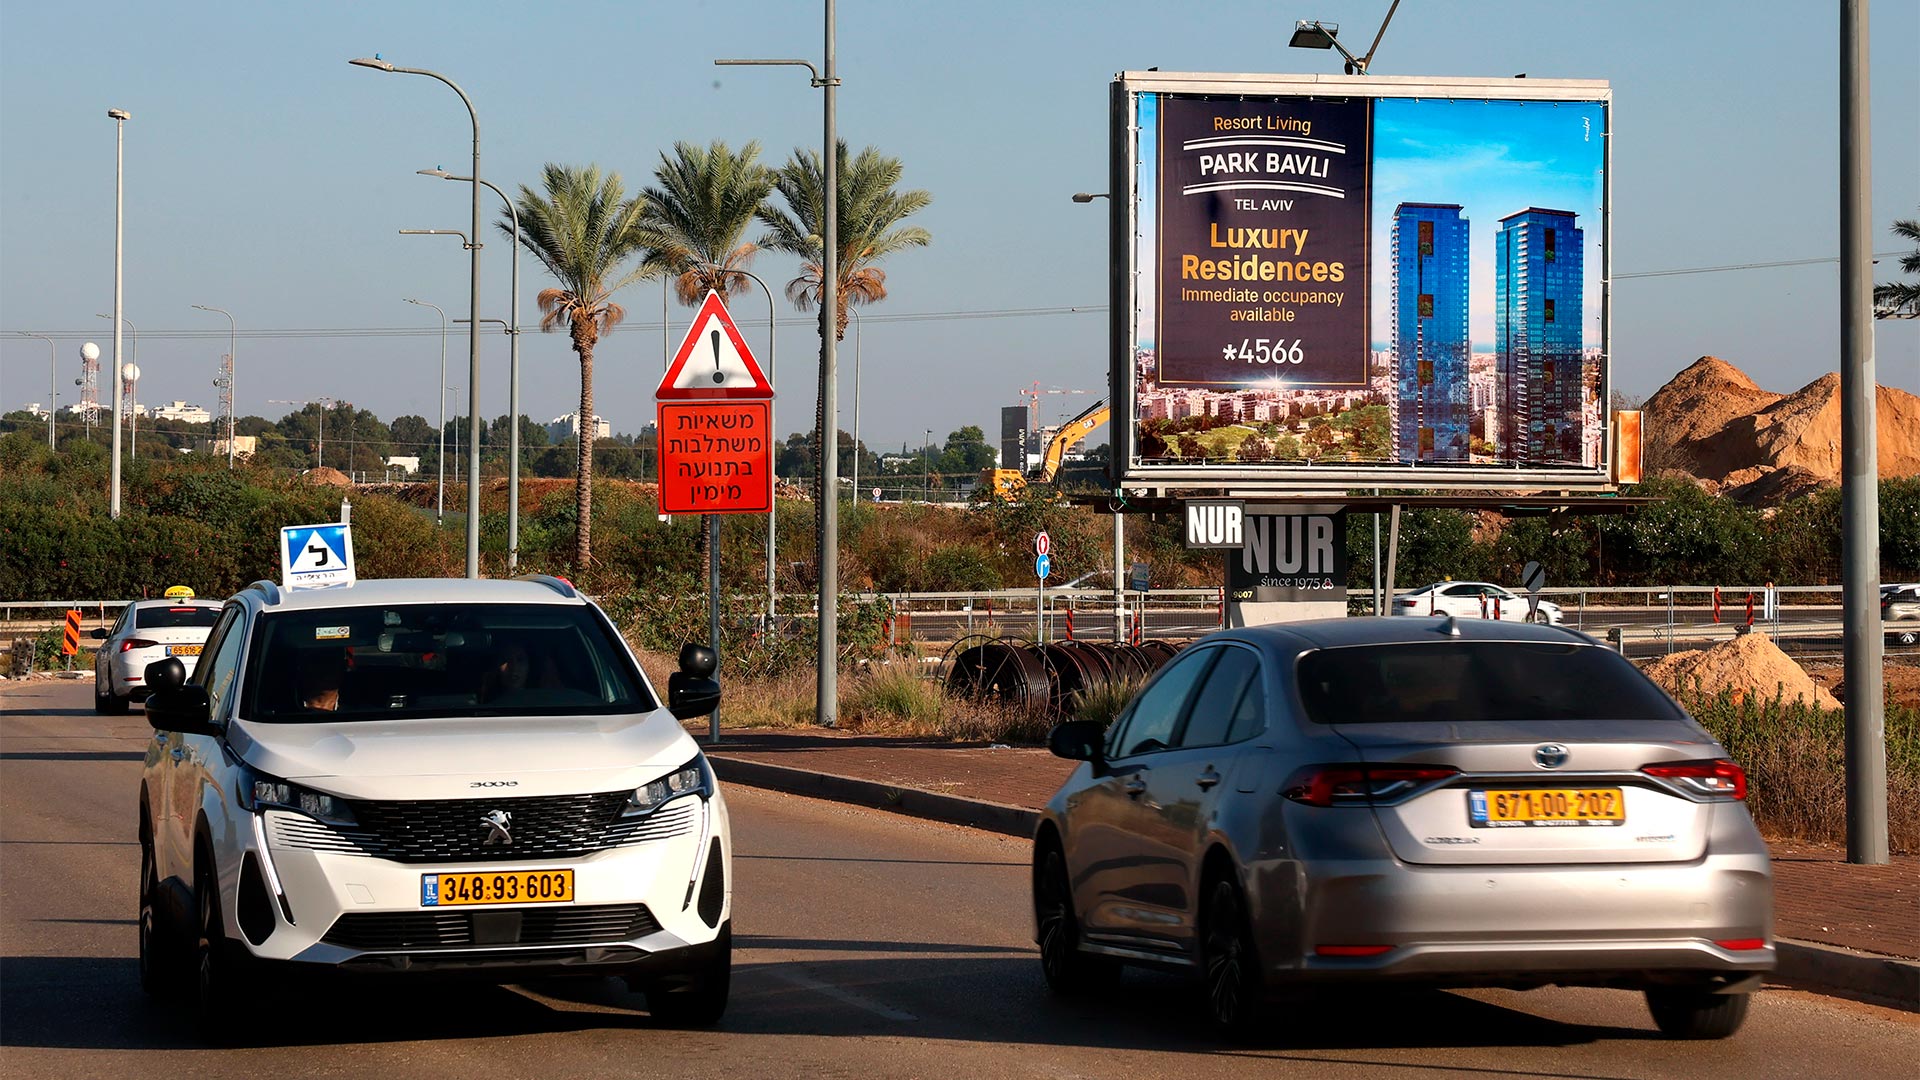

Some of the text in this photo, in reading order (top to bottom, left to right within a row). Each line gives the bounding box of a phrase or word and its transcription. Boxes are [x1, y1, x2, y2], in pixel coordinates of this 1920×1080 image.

[1213, 115, 1312, 136] Resort Living
[1199, 152, 1330, 178] PARK BAVLI
[1234, 198, 1294, 212] TEL AVIV
[1210, 222, 1309, 256] Luxury
[1181, 254, 1345, 282] Residences
[1181, 286, 1345, 307] Immediate occupancy
[1230, 306, 1296, 322] available
[677, 414, 754, 430] משאיות
[669, 434, 761, 453] משתלבות
[679, 461, 752, 478] בתנועה
[691, 485, 742, 504] מימין
[1188, 506, 1242, 544] NUR
[1243, 516, 1334, 574] NUR
[308, 545, 329, 566] ל
[1260, 575, 1320, 591] since 1975
[1232, 590, 1253, 599] 9007
